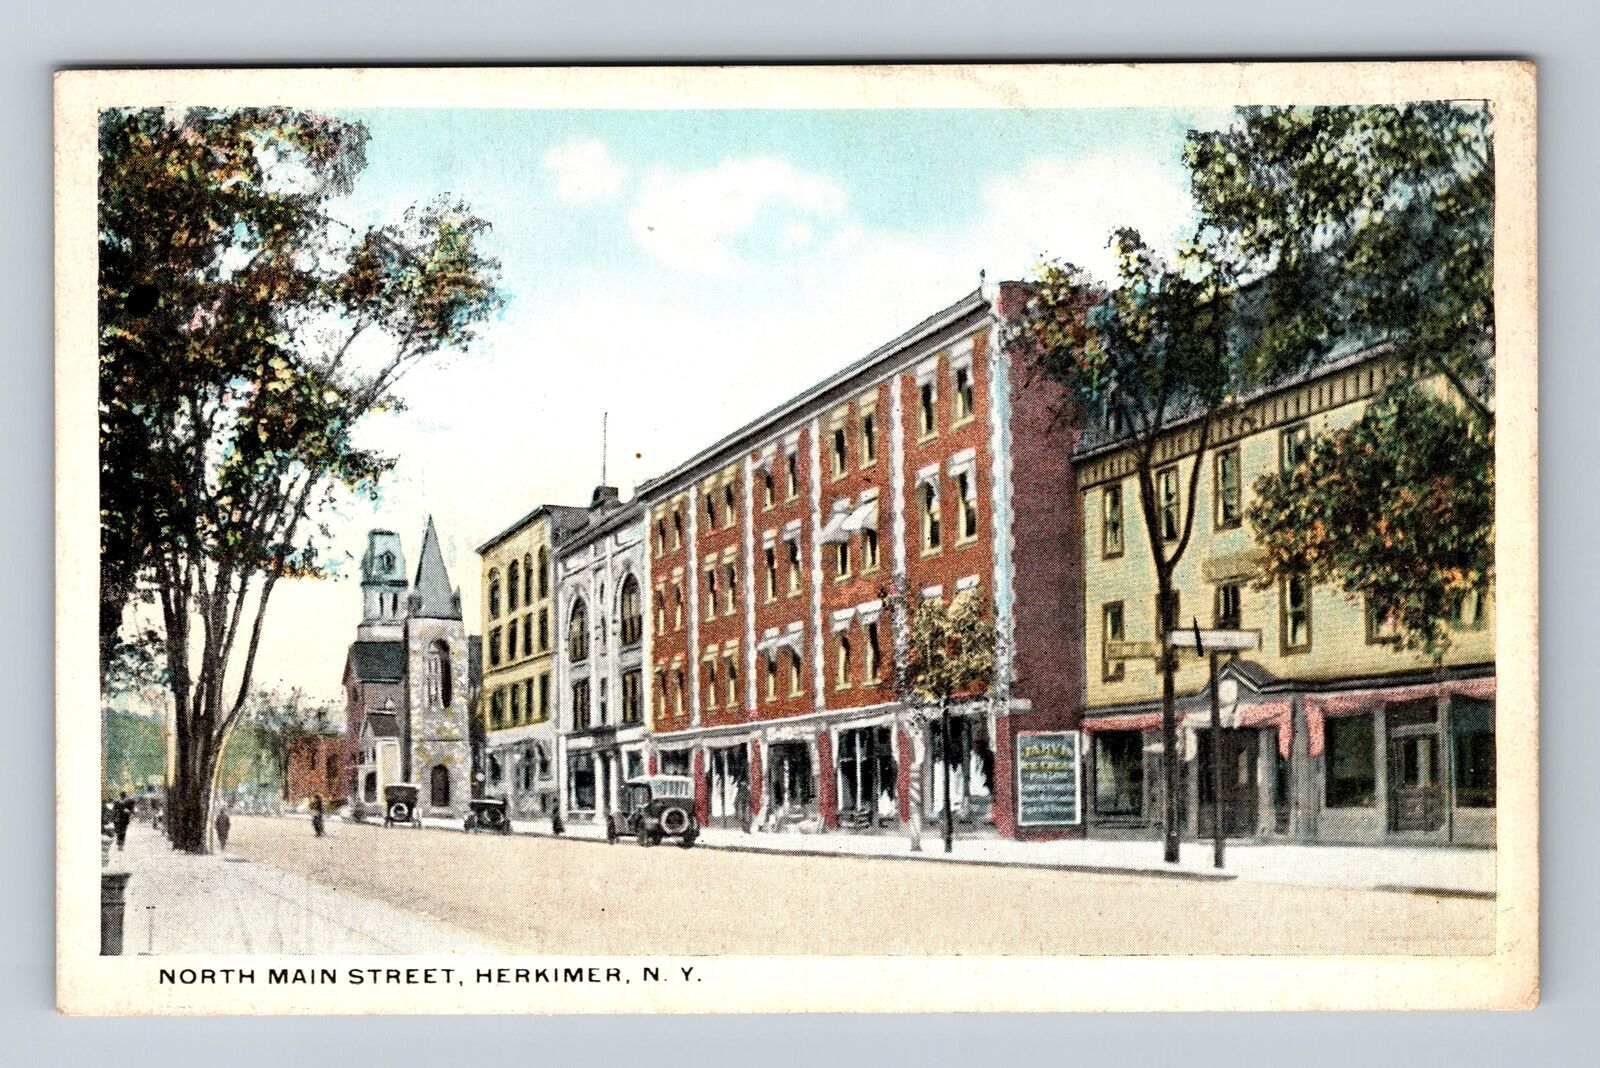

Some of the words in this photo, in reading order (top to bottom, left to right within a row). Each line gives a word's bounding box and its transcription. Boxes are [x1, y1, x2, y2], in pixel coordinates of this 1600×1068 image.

[159, 968, 254, 985] NORTH
[268, 968, 336, 985] MAIN
[348, 968, 462, 986] STREET,
[476, 967, 629, 984] HERKIMER,
[643, 967, 667, 982] N.
[680, 966, 701, 982] Y.
